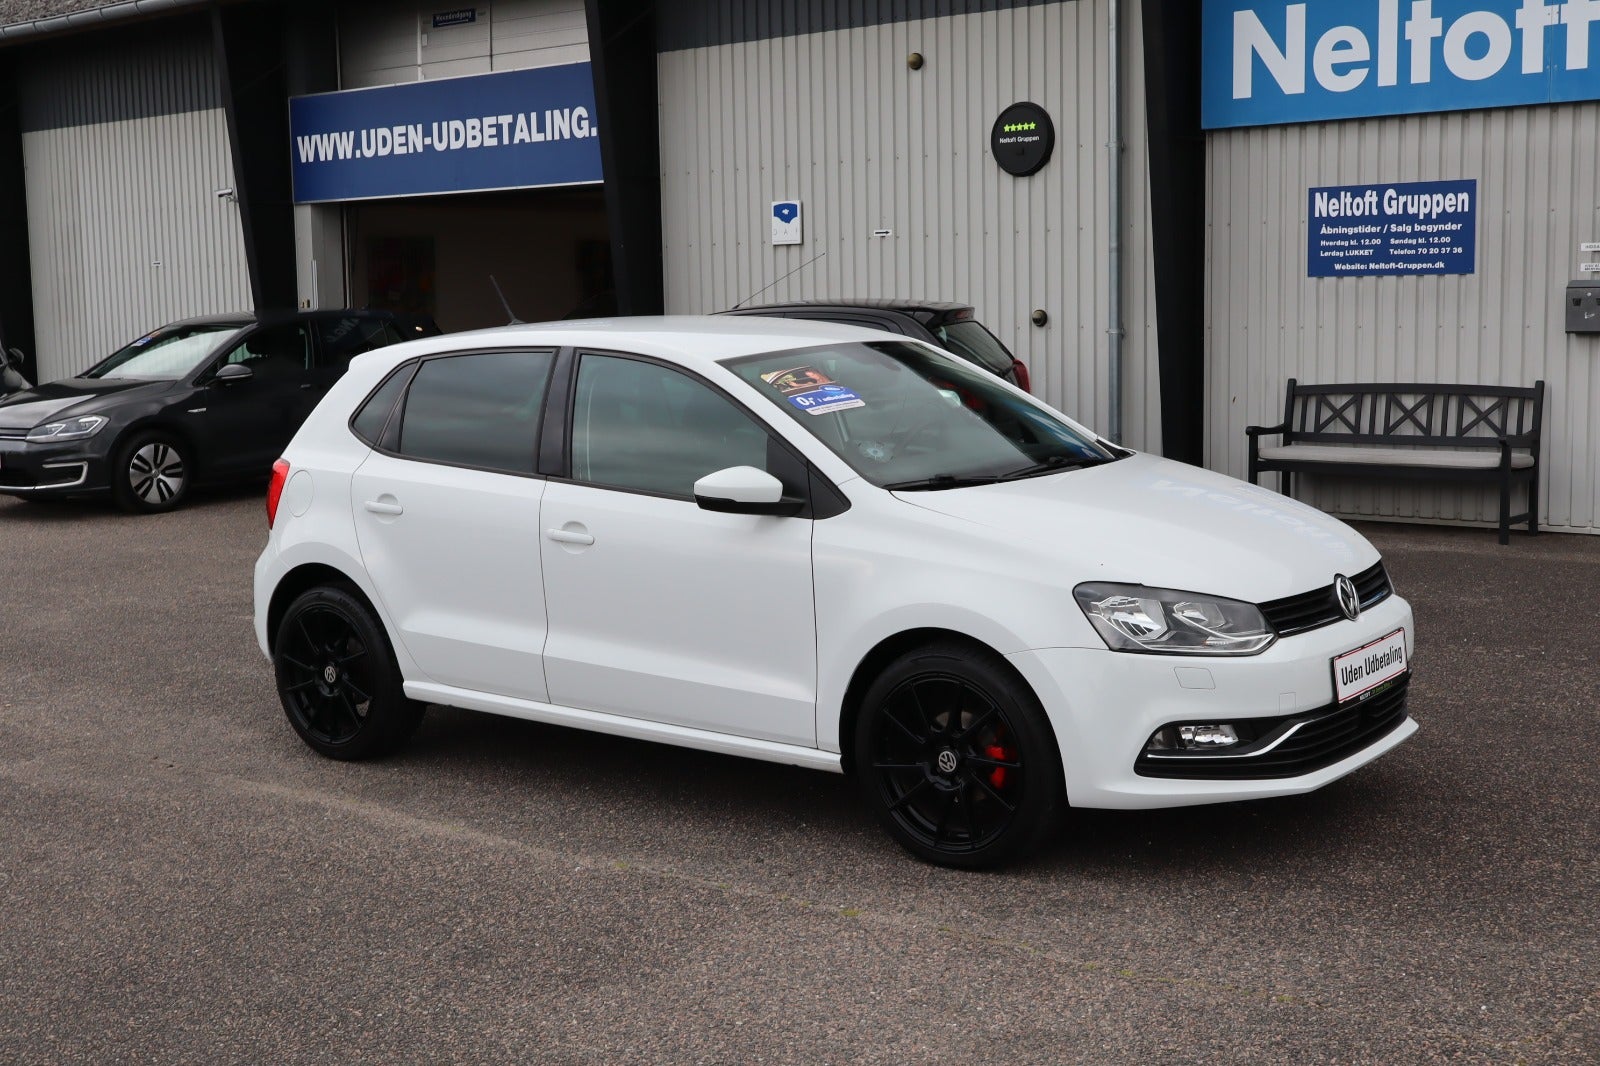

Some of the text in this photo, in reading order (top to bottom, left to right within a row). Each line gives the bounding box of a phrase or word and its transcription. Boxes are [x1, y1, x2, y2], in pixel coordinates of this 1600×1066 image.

[296, 106, 598, 163] WWW.UDEN-UDBETALING.
[1017, 135, 1040, 143] Gruppen
[1314, 188, 1469, 219] Neltoft Gruppen
[1320, 224, 1382, 235] Åbningstider
[1390, 223, 1412, 234] Salg
[1414, 222, 1462, 233] begynder
[1320, 239, 1349, 247] Hverdag
[1429, 236, 1451, 244] 12.00
[1334, 261, 1445, 270] Website: Neltoft-Gruppen.dk
[1341, 645, 1403, 686] Uden Udbetaling
